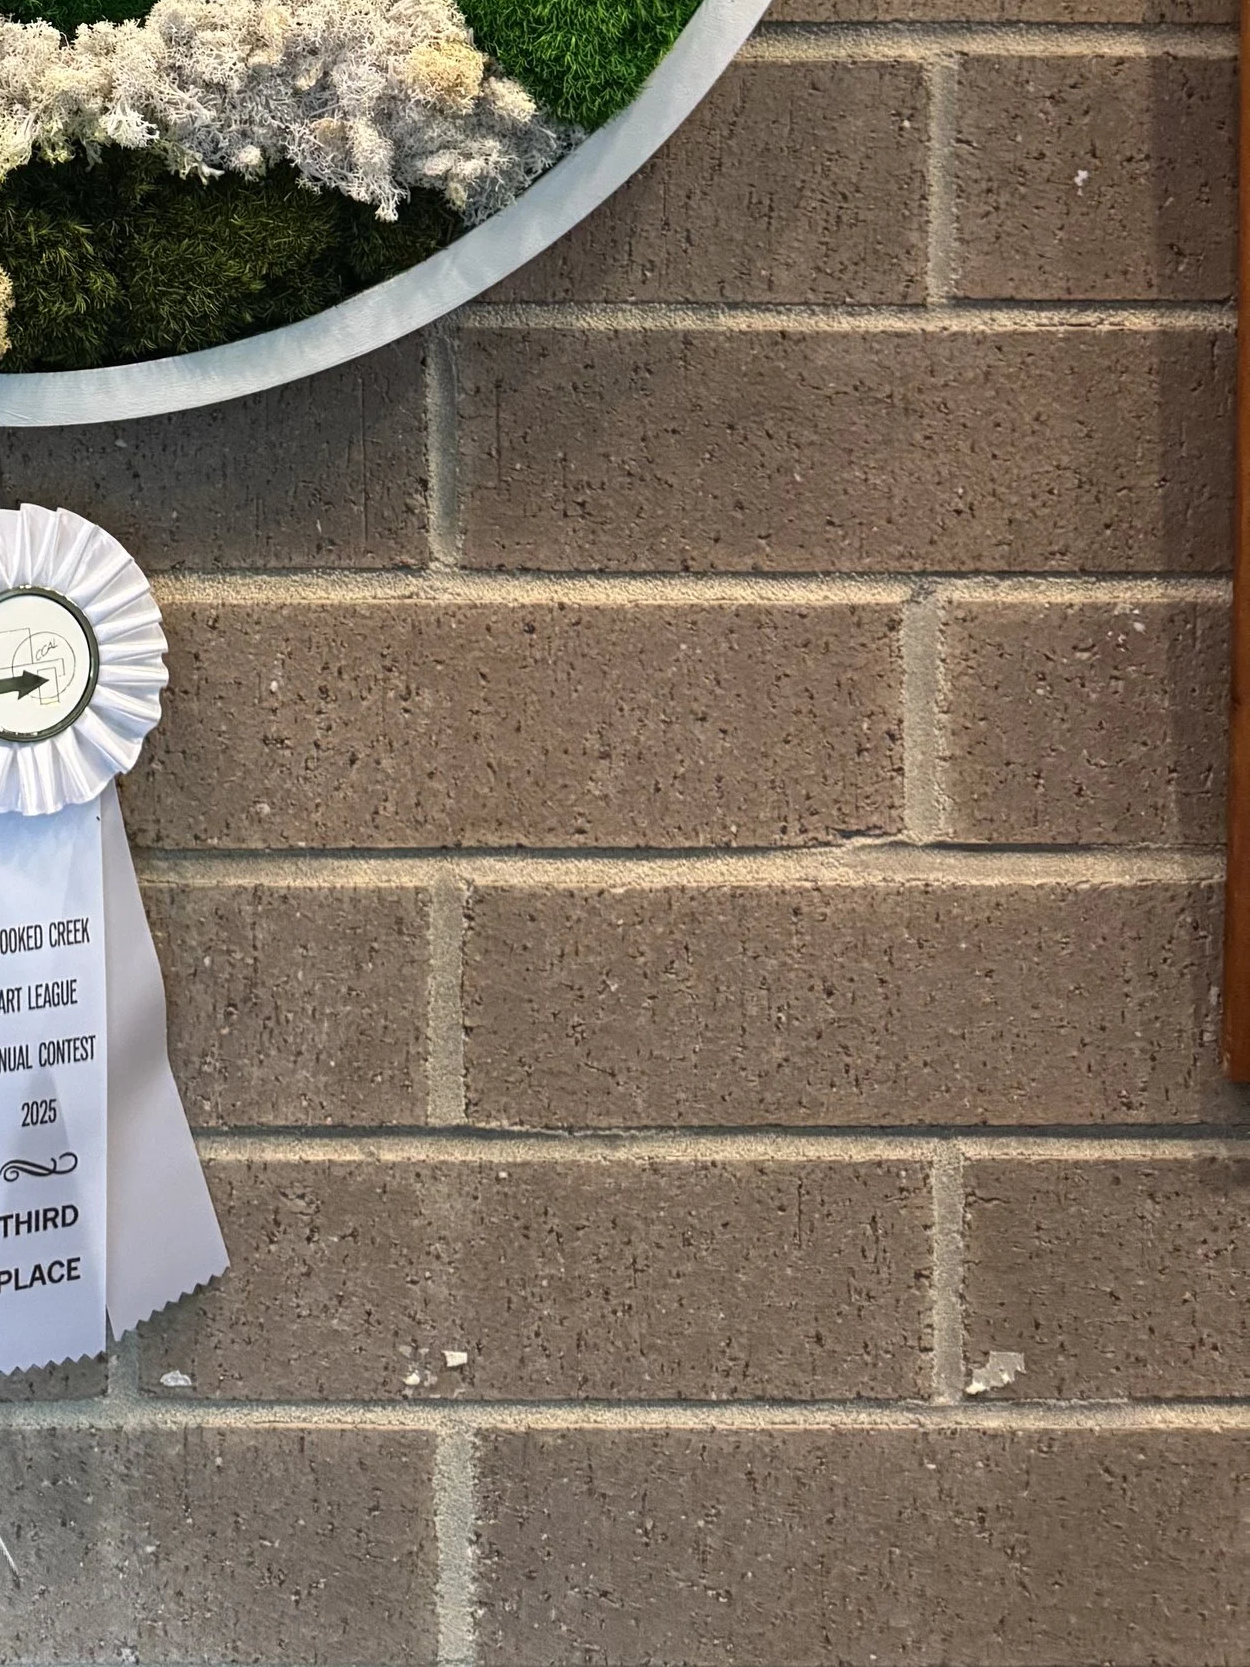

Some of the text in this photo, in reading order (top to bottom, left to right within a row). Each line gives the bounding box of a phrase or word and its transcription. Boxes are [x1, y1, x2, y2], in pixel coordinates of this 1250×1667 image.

[49, 917, 91, 948] CREEK
[27, 979, 78, 1011] LEAGUE
[38, 1035, 96, 1068] CONTEST
[21, 1099, 57, 1127] 2025
